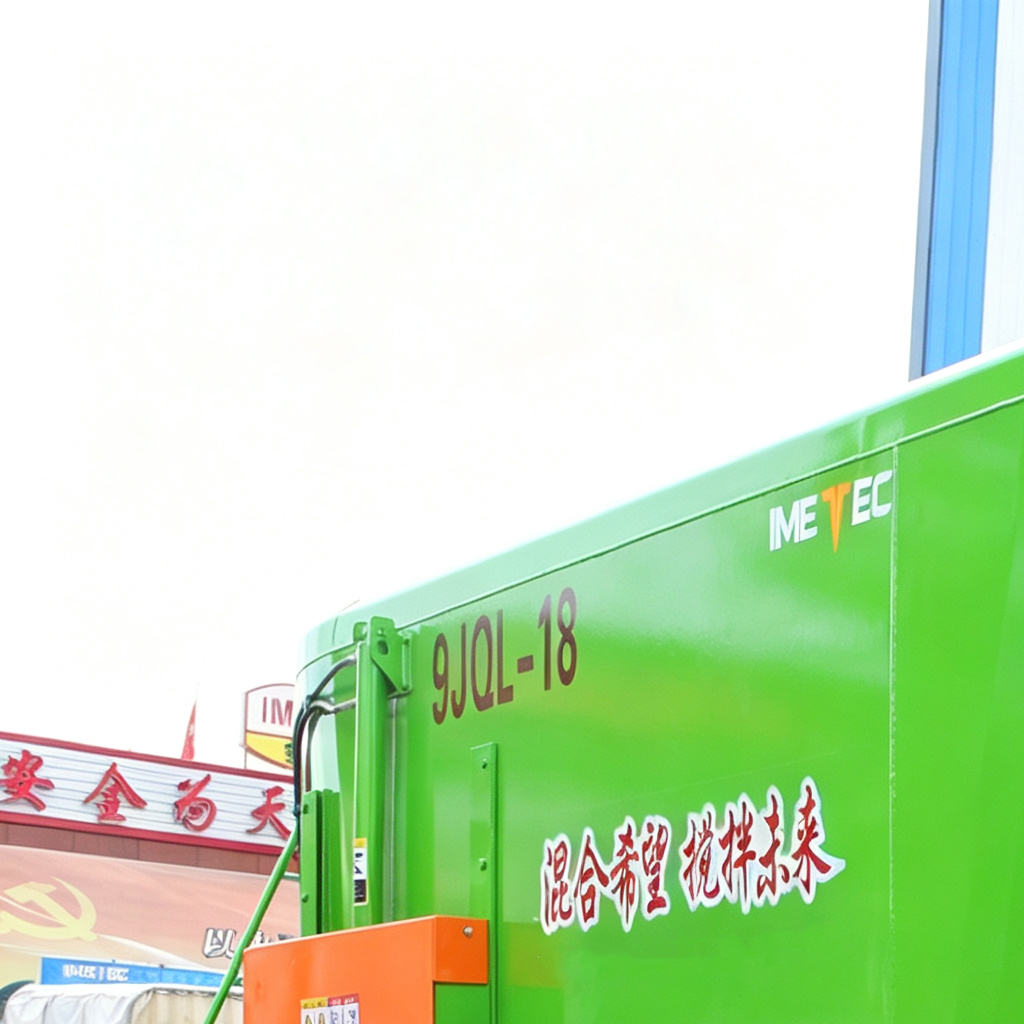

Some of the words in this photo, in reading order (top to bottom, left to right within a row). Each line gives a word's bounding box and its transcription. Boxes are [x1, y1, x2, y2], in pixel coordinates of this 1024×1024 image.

[769, 470, 893, 553] IMETEC
[432, 587, 578, 725] 9JQL-18
[542, 817, 671, 934] 混合希望
[681, 779, 841, 909] 搅拌未来
